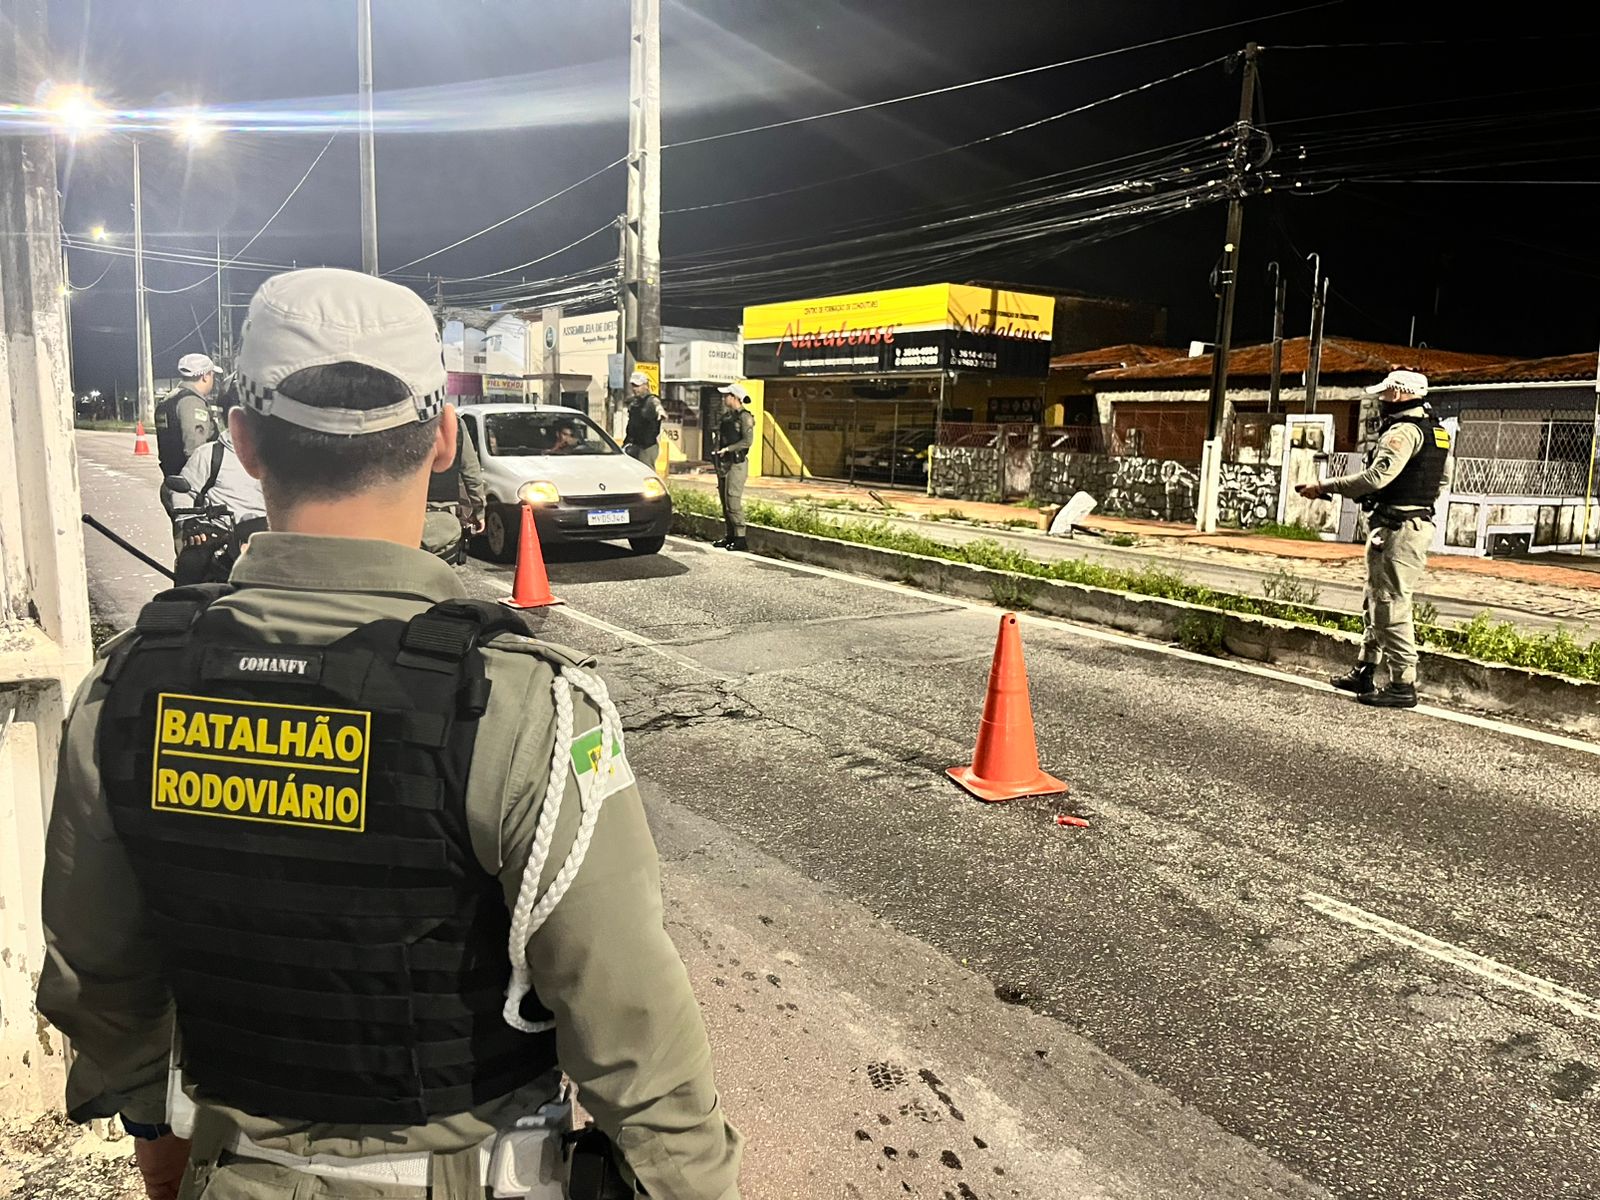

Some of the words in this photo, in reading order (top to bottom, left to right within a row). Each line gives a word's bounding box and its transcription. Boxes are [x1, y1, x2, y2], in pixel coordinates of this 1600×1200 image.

[776, 319, 895, 358] Natalense
[161, 708, 363, 762] BATALHÃO
[157, 767, 360, 823] RODOVIÁRIO
